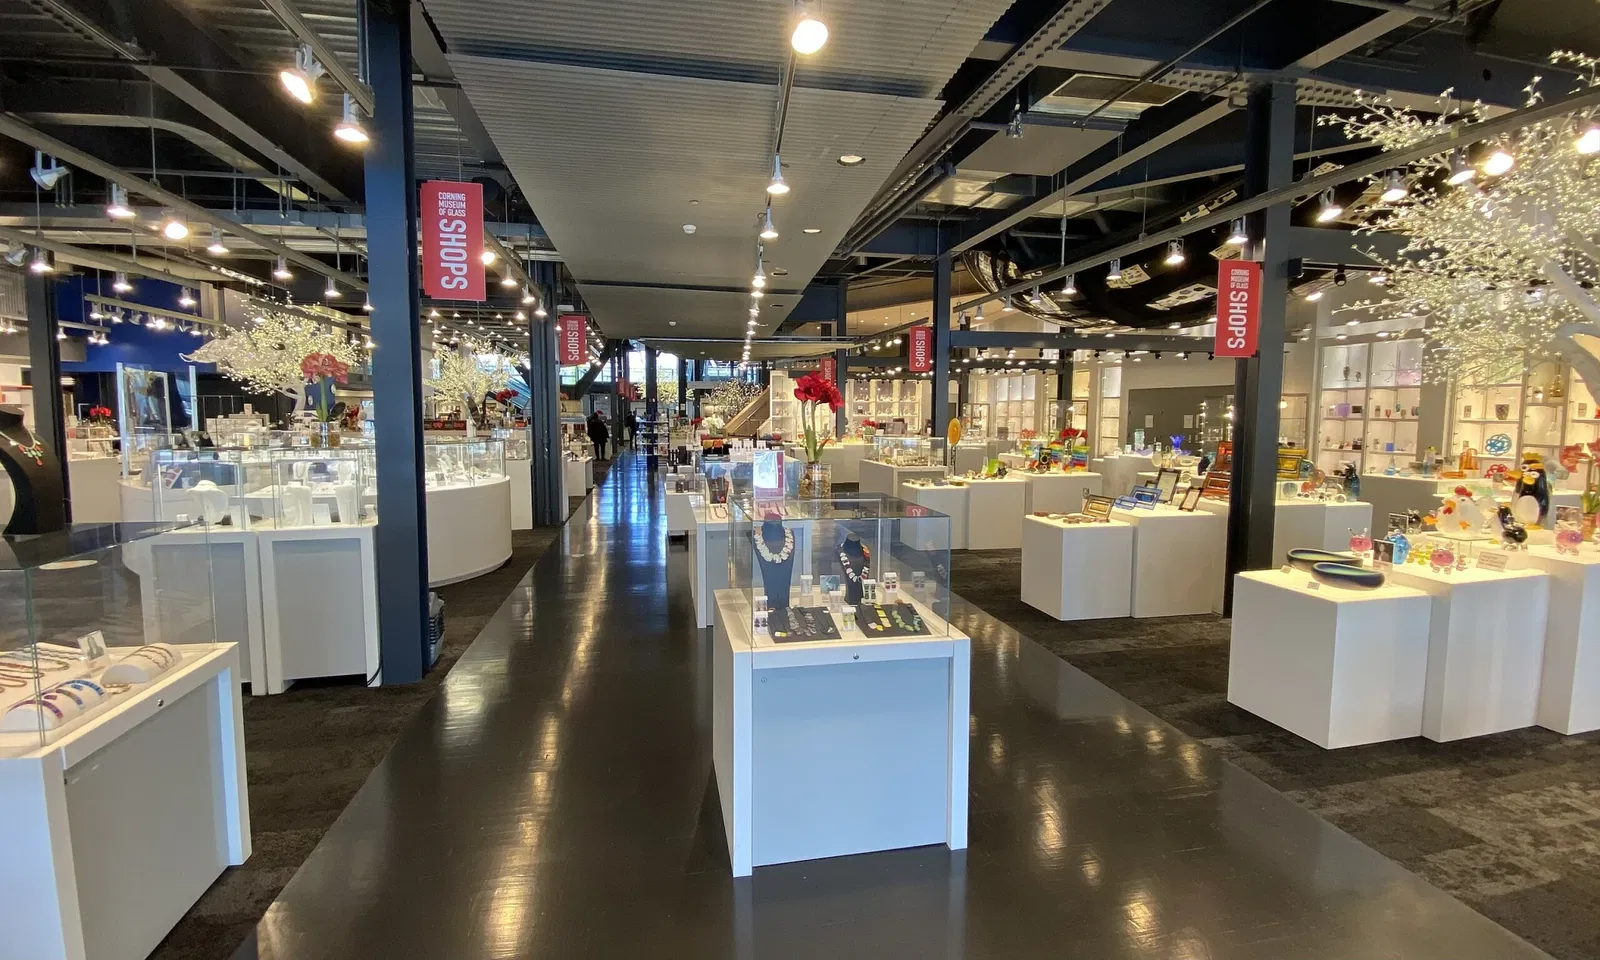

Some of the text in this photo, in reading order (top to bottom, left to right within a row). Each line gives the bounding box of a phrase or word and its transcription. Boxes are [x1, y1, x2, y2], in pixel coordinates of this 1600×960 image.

[438, 191, 466, 201] CORNING
[438, 200, 466, 209] MUSEUM
[438, 208, 466, 217] OF GLASS
[439, 218, 468, 290] SHOPS
[1226, 290, 1249, 349] SHOPS
[567, 331, 579, 361] SHOPS
[915, 340, 926, 368] SHOPS
